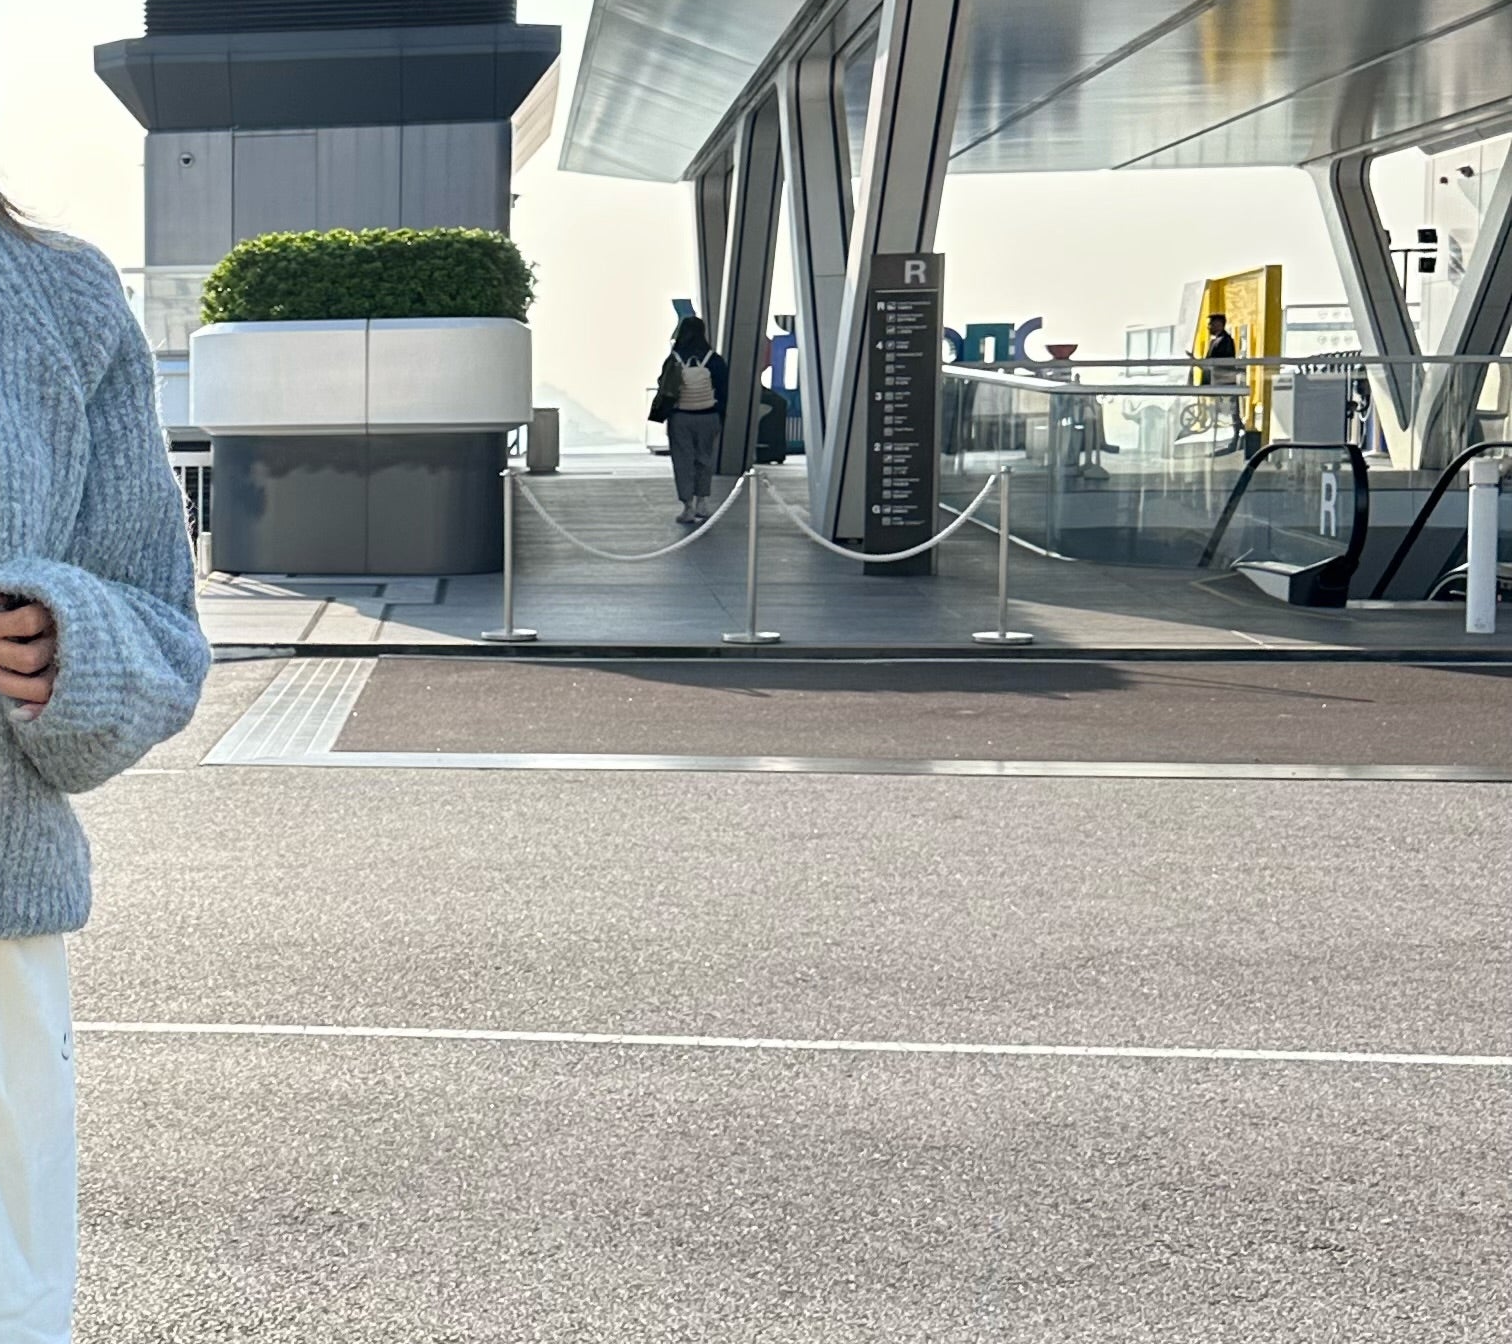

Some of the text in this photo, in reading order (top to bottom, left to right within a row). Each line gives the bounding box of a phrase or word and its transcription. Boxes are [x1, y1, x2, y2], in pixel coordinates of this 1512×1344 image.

[904, 260, 926, 284] R
[875, 340, 883, 350] 4
[875, 391, 882, 401] 3
[873, 442, 881, 452] 2
[1320, 472, 1337, 536] R
